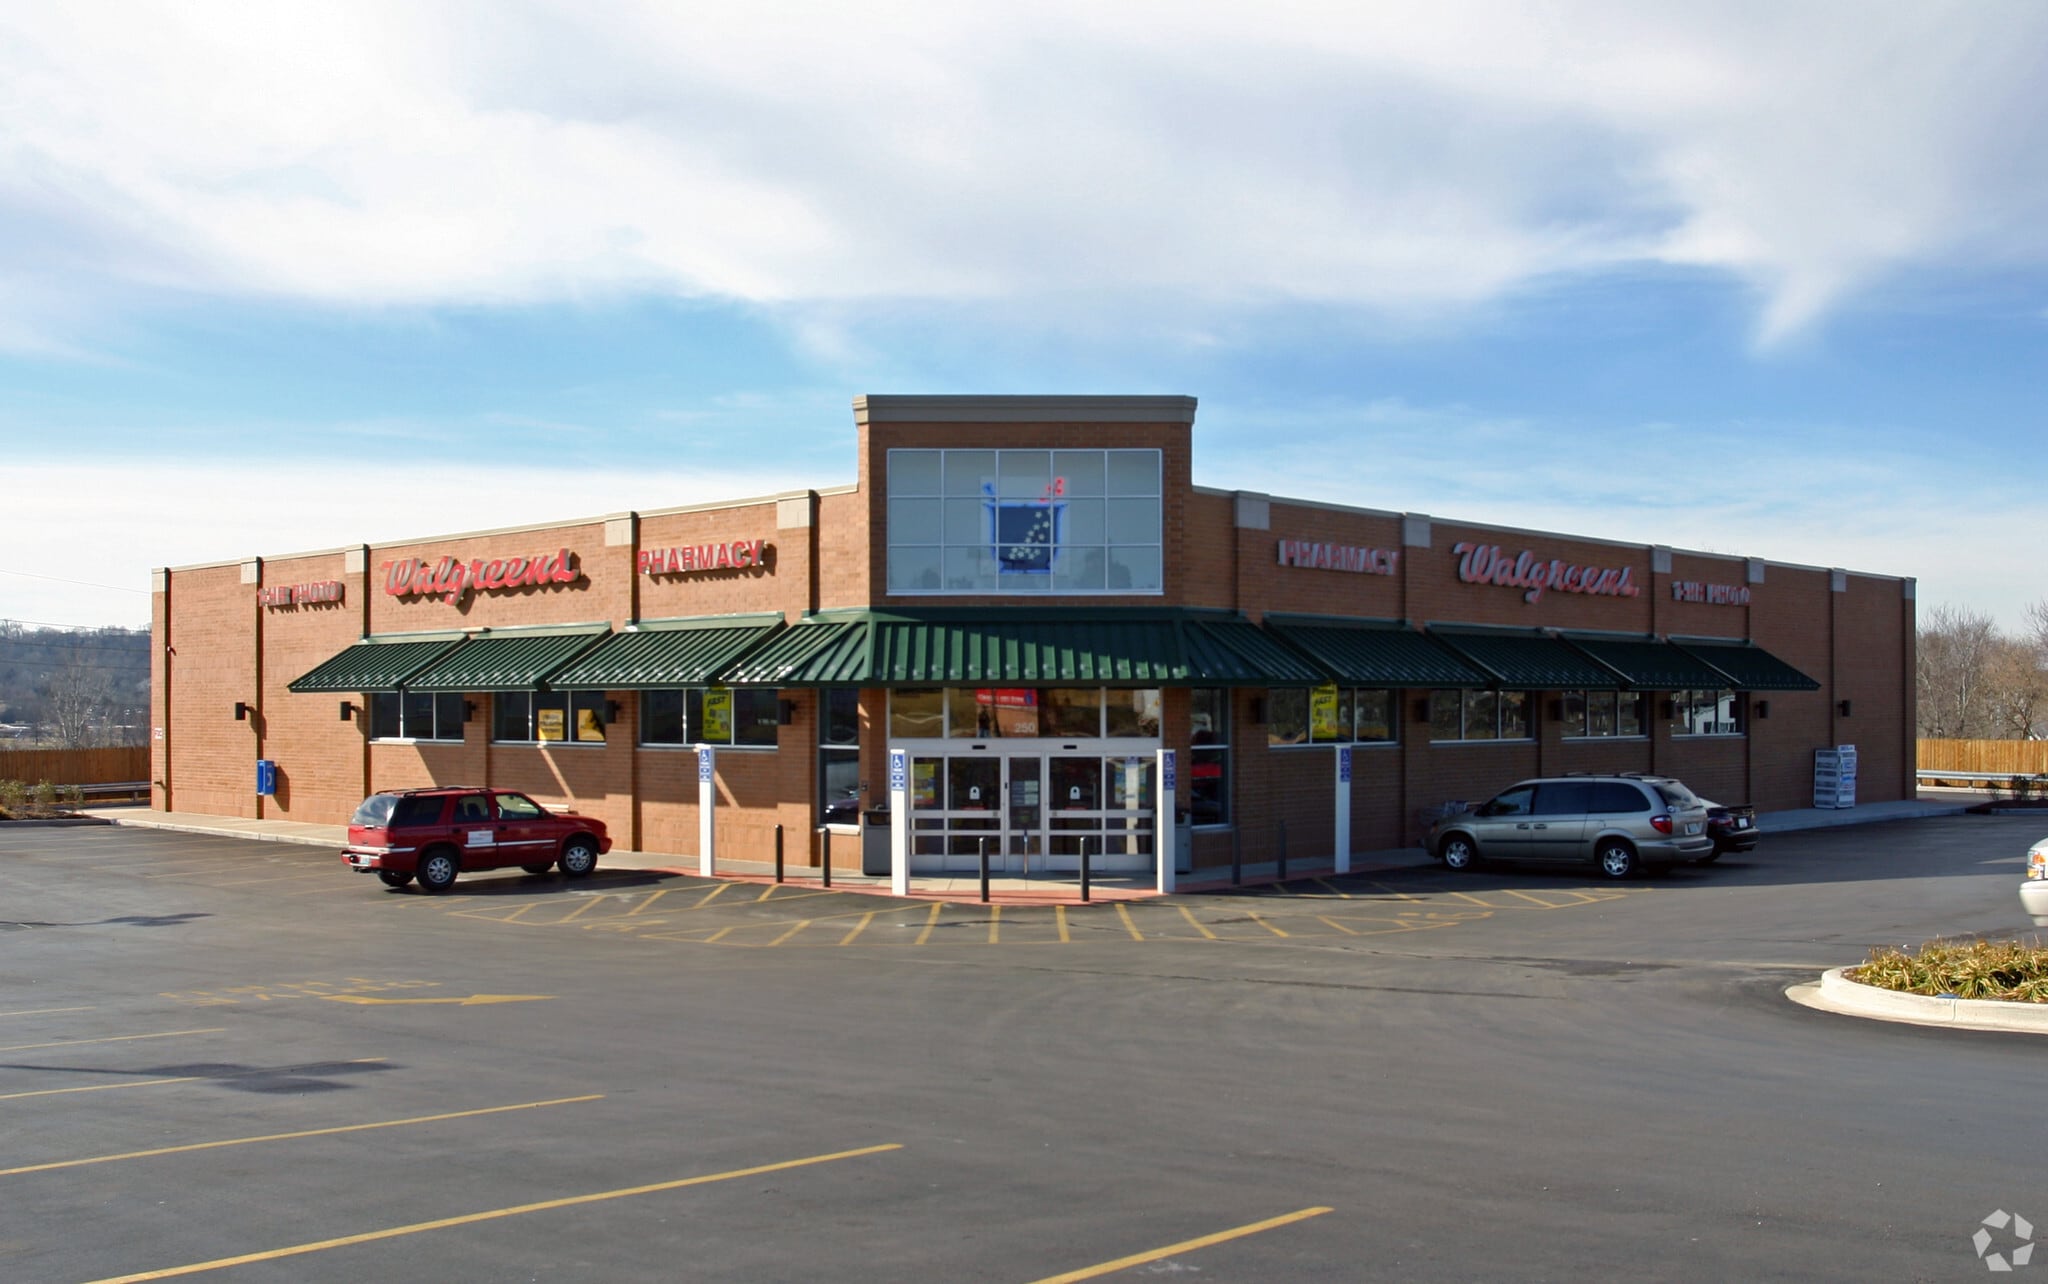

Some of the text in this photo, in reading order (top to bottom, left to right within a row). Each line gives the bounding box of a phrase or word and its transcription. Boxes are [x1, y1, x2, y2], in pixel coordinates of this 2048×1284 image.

[637, 539, 765, 575] PHARMACY
[1279, 540, 1399, 576] PHARMACY
[1454, 542, 1640, 603] Walgreens
[292, 581, 343, 604] PHOTO
[381, 548, 579, 606] Walgreens
[1706, 583, 1751, 607] PHOTO
[1014, 722, 1036, 733] 250
